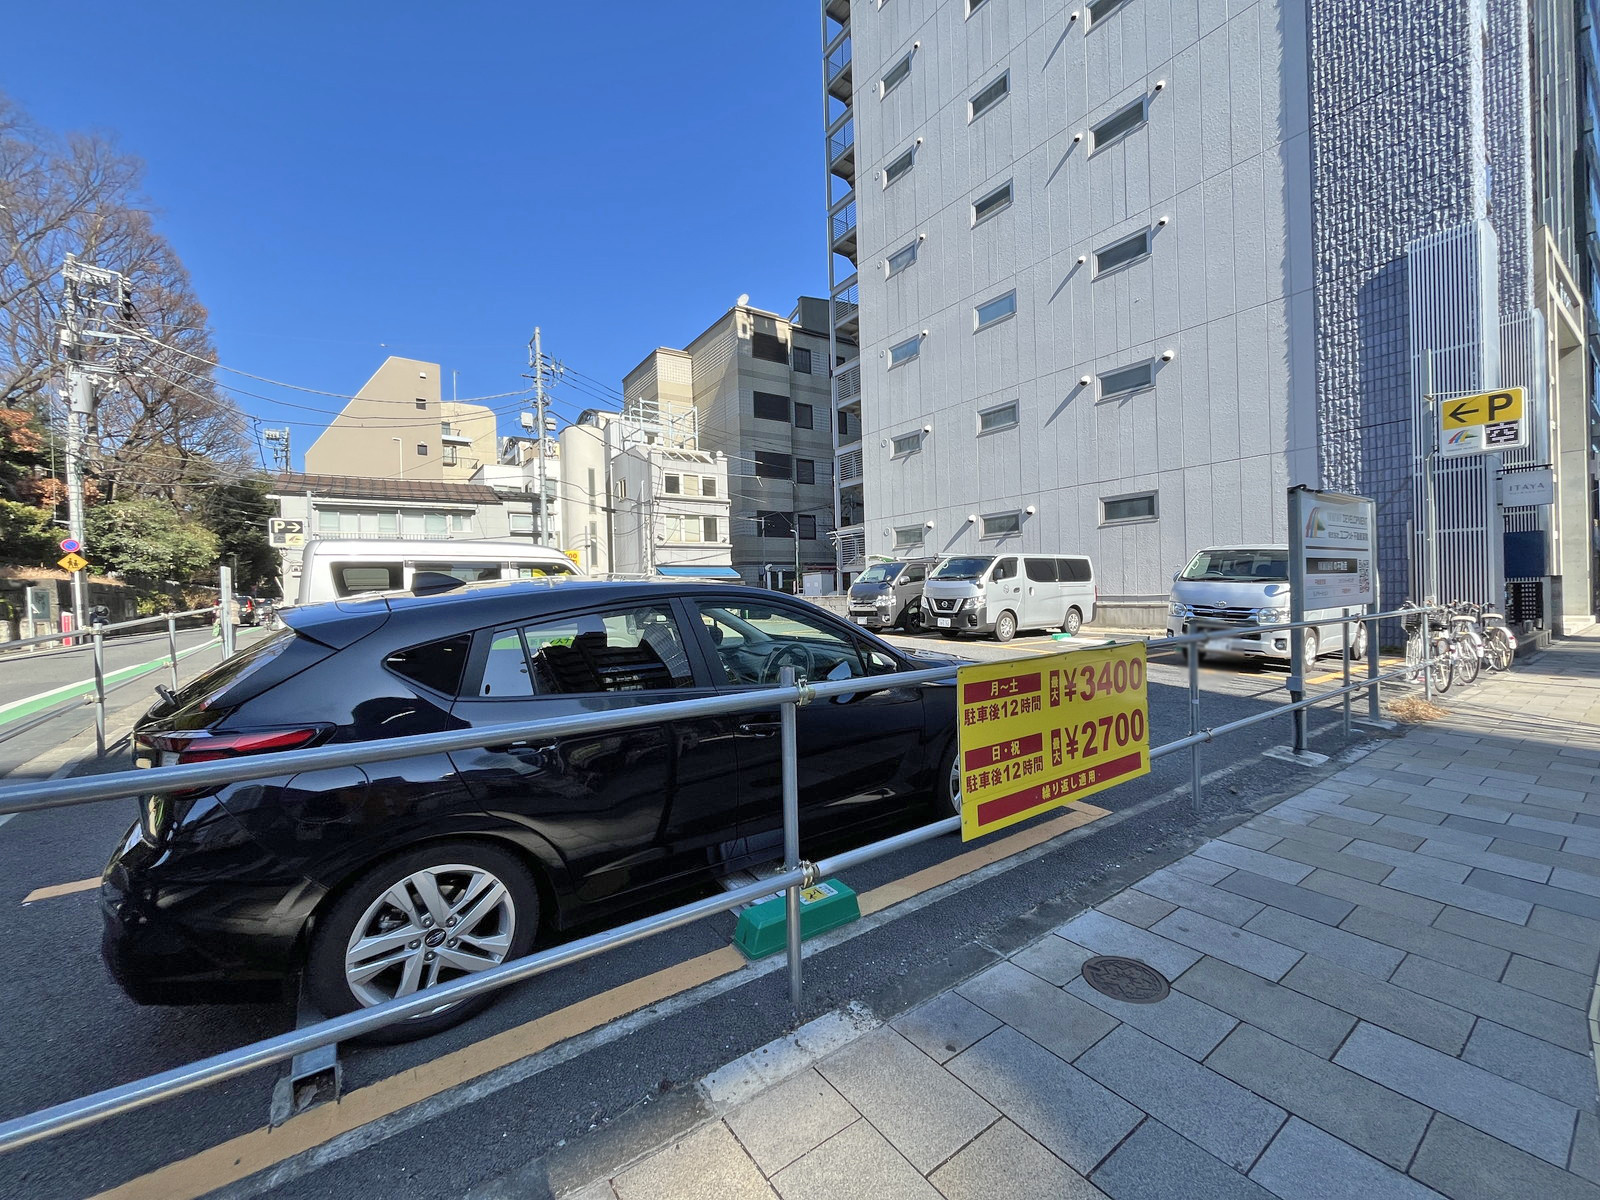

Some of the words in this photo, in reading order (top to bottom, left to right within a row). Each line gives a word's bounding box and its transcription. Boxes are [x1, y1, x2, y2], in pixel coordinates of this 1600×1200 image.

[1488, 393, 1513, 421] P
[1486, 422, 1519, 443] 空
[1509, 482, 1545, 492] ITAYA
[274, 521, 285, 533] P
[1050, 676, 1059, 702] 最大
[1063, 657, 1143, 702] ¥3400
[963, 695, 1042, 726] 駐車後12時間
[1064, 708, 1144, 760] ¥2700
[1052, 736, 1061, 763] 最大
[965, 755, 1044, 794] 駐車後12時間
[1041, 770, 1097, 800] 繰り返し適用
